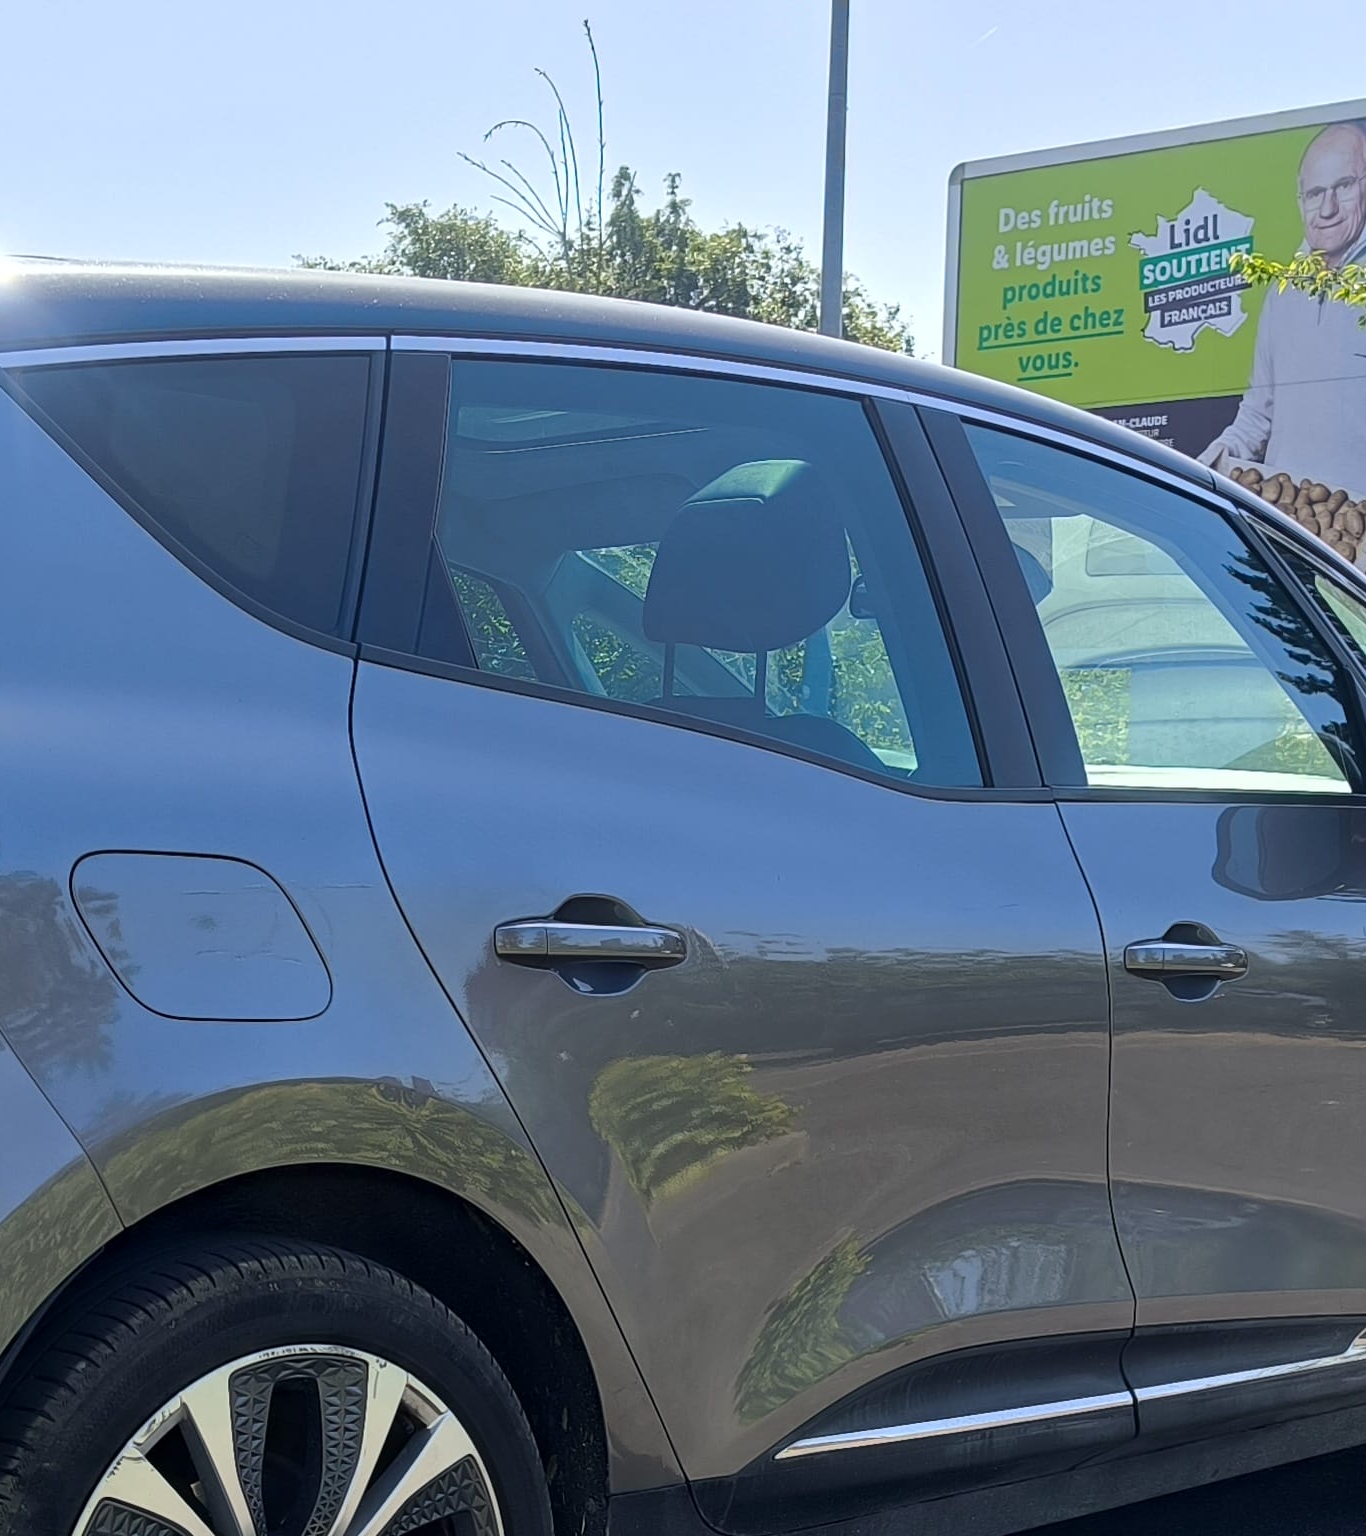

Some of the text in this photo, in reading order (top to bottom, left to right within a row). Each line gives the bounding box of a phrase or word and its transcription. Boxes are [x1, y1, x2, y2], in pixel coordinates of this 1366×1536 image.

[999, 194, 1114, 233] Des fruits
[1169, 213, 1220, 250] Lidl
[992, 235, 1116, 271] & légumes
[1143, 243, 1251, 285] SOUTIENT
[1002, 269, 1102, 310] produits
[1148, 292, 1168, 307] LES
[978, 305, 1125, 350] près de chez
[1164, 301, 1229, 325] FRANÇAIS
[1018, 351, 1079, 374] vous.
